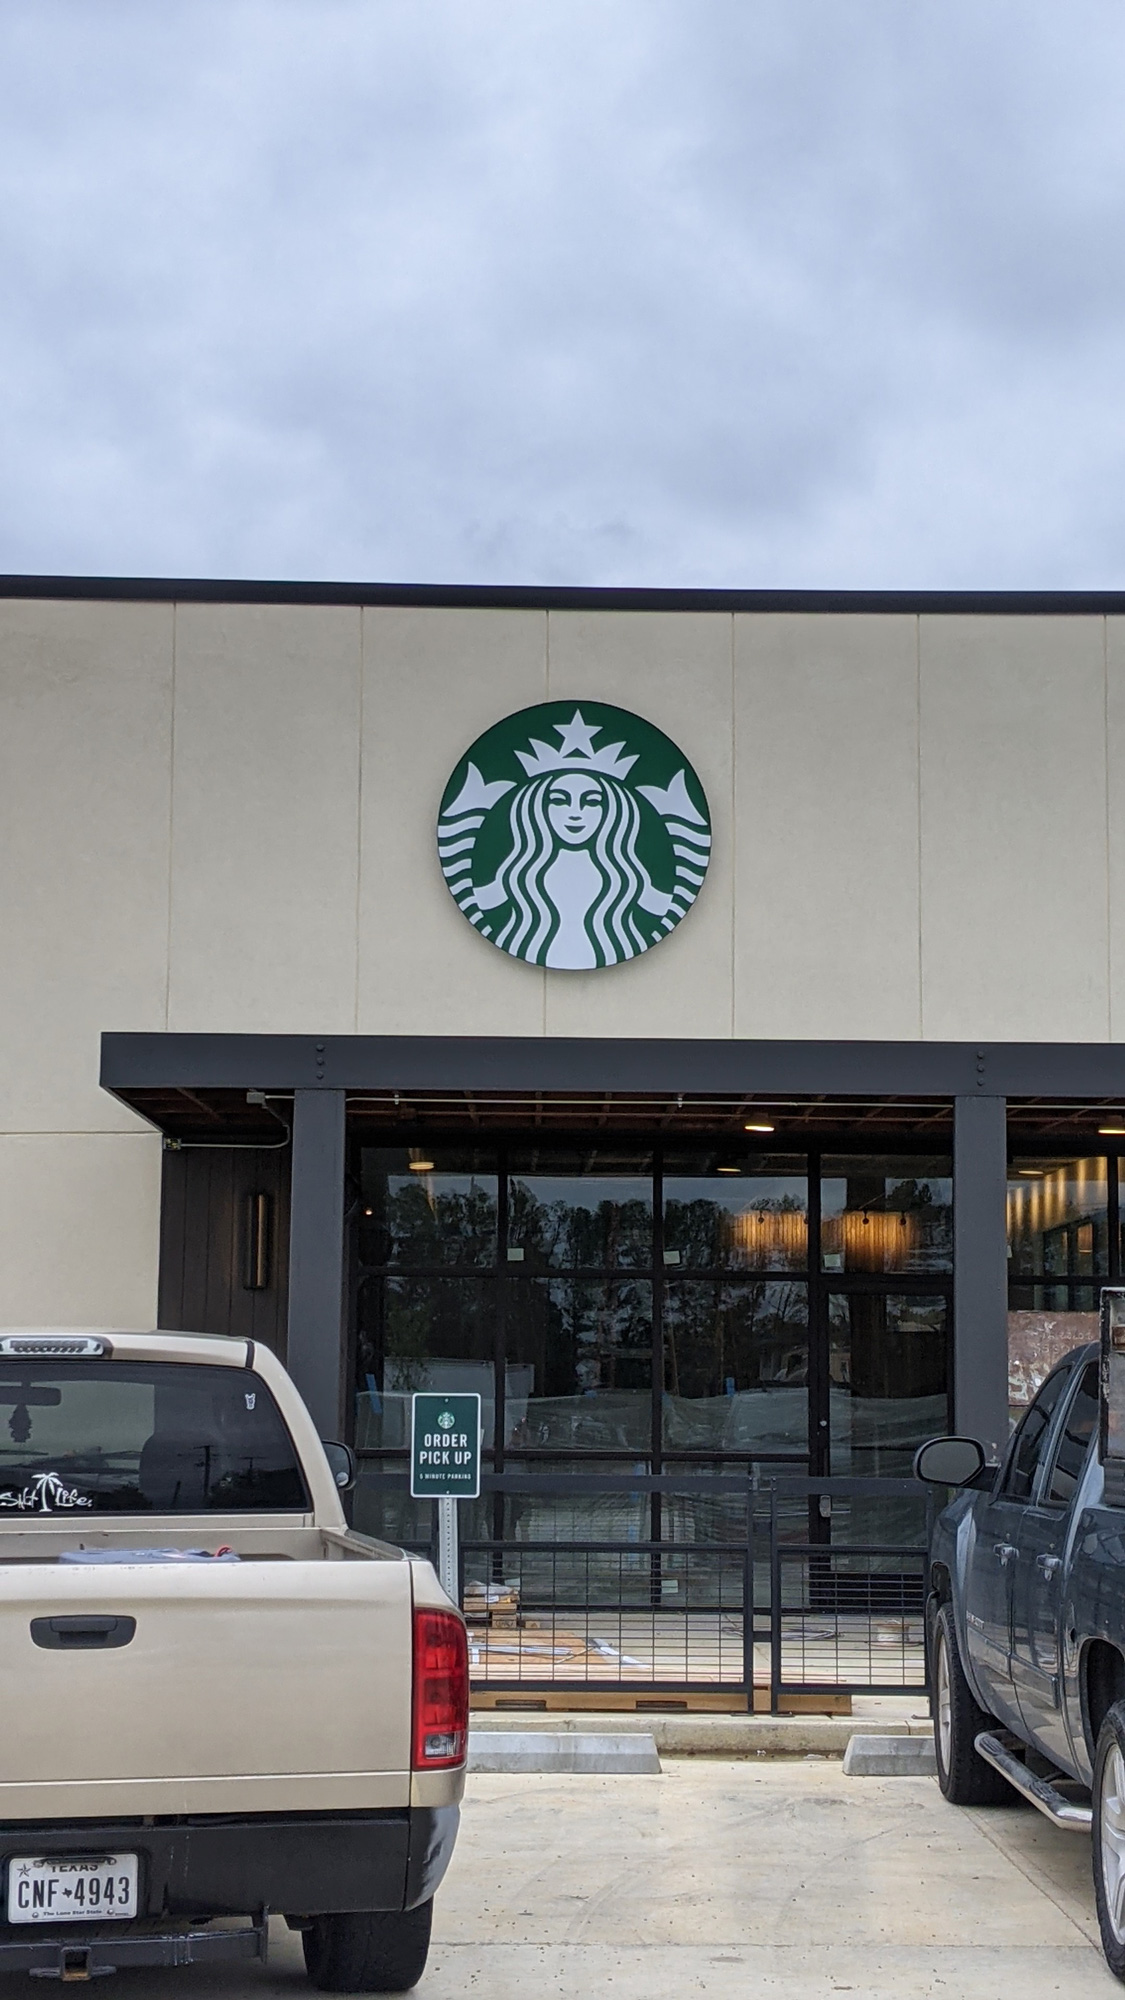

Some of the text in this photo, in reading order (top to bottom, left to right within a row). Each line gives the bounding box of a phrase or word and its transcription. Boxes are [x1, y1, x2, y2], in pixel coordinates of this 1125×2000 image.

[424, 1433, 467, 1447] ORDER
[419, 1451, 472, 1465] PICK UP
[18, 1876, 130, 1909] CNF 4943
